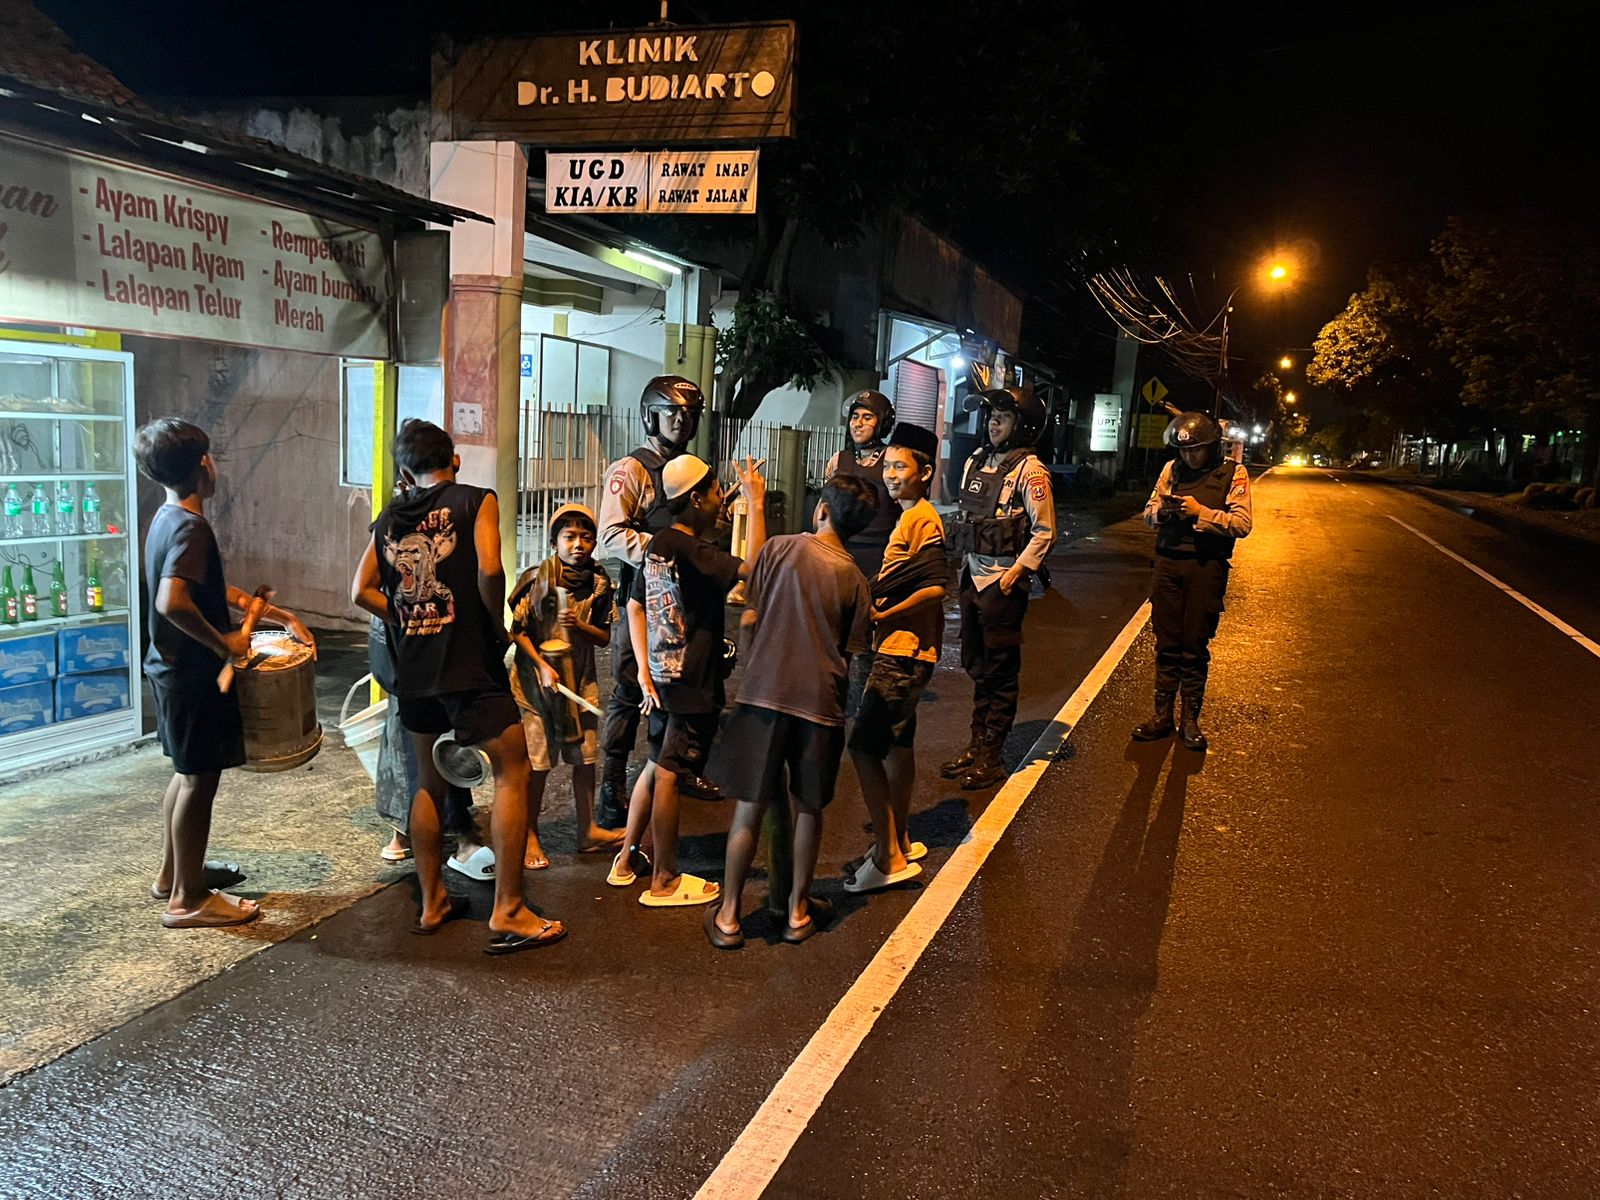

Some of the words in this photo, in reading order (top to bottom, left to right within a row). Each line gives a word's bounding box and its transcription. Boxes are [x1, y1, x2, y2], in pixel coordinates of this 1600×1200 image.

[579, 36, 698, 66] KLINIK
[517, 80, 560, 106] Dr.
[568, 79, 597, 104] H.
[606, 71, 775, 102] BUDIARTO
[569, 159, 625, 180] UGD
[661, 163, 705, 177] RAWAT
[715, 163, 749, 177] INAP
[0, 184, 58, 218] an
[96, 177, 158, 223] Ayam
[163, 193, 229, 246] Krispy
[554, 186, 639, 207] KIA/KB
[658, 189, 699, 203] RAWAT
[705, 189, 748, 203] JALAN
[98, 223, 187, 273] Lalapan
[192, 242, 245, 284] Ayam
[272, 220, 341, 264] Rempelo
[346, 240, 366, 269] Ati
[102, 269, 190, 316] Lalapan
[193, 284, 242, 319] Telur
[274, 259, 318, 298] Ayam
[321, 270, 377, 304] bumbu
[274, 298, 325, 333] Merah
[1097, 418, 1117, 426] UPT
